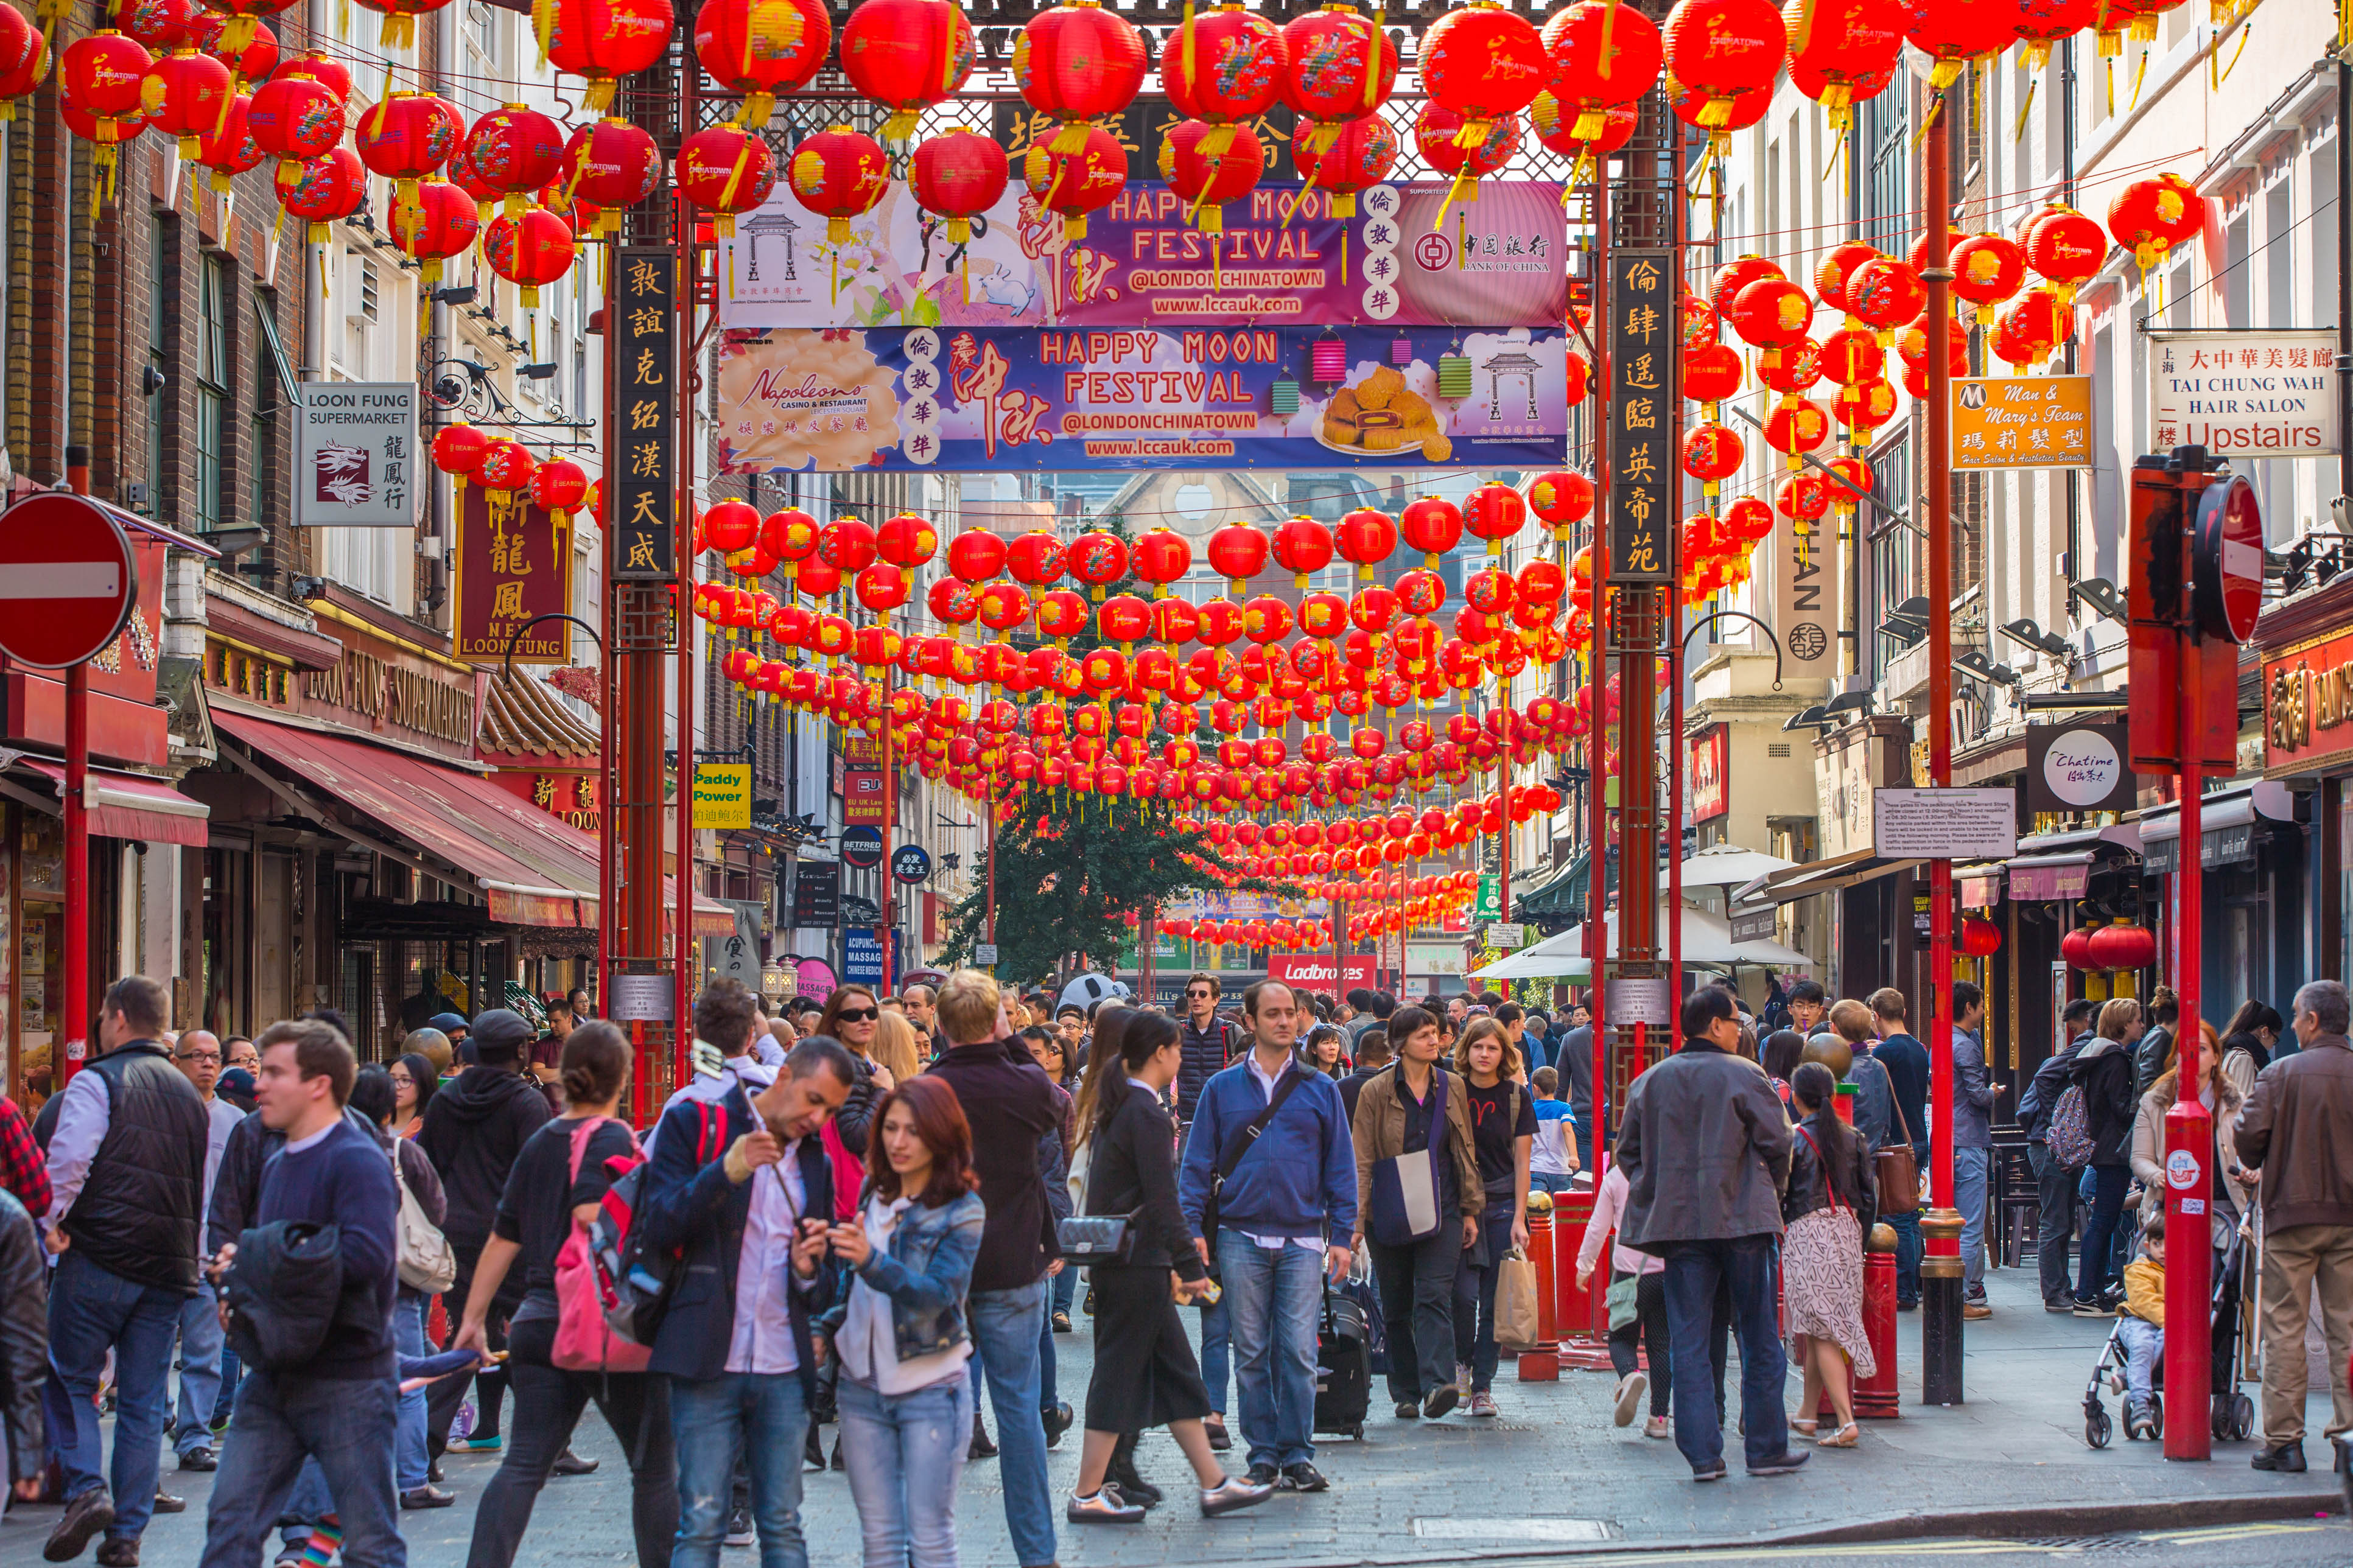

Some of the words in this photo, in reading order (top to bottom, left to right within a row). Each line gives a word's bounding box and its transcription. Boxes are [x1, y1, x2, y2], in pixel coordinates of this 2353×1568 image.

[612, 15, 665, 28] CHINATOWN
[1846, 28, 1895, 38] CHINATOWN
[1710, 36, 1764, 46] CHINATOWN
[1492, 58, 1538, 74] CHINATOWN
[96, 71, 139, 80] CHINATOWN
[1420, 128, 1457, 139] CHINATOWN
[689, 166, 732, 175] CHINATOWN
[1089, 171, 1124, 181] CHINATOWN
[1110, 189, 1203, 221] HAP
[1133, 229, 1321, 261] FESTIVAL
[1369, 190, 1393, 312] 倫敦華埠
[1464, 233, 1550, 258] 中國銀行
[2055, 245, 2092, 254] CHINATOWN
[1464, 262, 1493, 272] BANK
[1496, 262, 1510, 271] OF
[1513, 262, 1549, 271] CHINA
[1131, 271, 1324, 288] @LONDONCHINATOWN
[738, 287, 804, 295] 倫敦華埠商會
[1155, 297, 1300, 313] www.lccauk.com
[1041, 332, 1158, 364] HAPPY
[1183, 331, 1277, 363] MOON
[2162, 348, 2174, 373] 上海
[2189, 348, 2333, 370] 大中華美髮廊
[738, 365, 869, 408] Napoleons
[1064, 371, 1254, 404] FESTIVAL
[2170, 379, 2200, 392] TAI
[2208, 377, 2275, 391] CHUNG
[2283, 377, 2324, 390] WAH
[309, 394, 356, 407] LOON
[362, 394, 409, 407] FUNG
[910, 335, 933, 458] 倫敦華埠
[2004, 384, 2041, 402] Man
[2046, 384, 2058, 400] &
[820, 399, 868, 408] RESTAURANT
[2189, 400, 2238, 414] HAIR
[2245, 399, 2306, 413] SALON
[309, 413, 408, 425] SUPERMARKET
[1064, 415, 1255, 432] @LONDONCHINATOWN
[1985, 406, 2039, 428] Mary's
[2043, 405, 2085, 423] Team
[1961, 427, 2085, 450] 瑪莉髮型
[2186, 421, 2322, 454] Upstairs
[1087, 439, 1233, 455] www.lccauk.com
[1962, 454, 1980, 464] Hair
[1983, 453, 2006, 463] Salon
[2008, 453, 2015, 463] &
[2016, 453, 2055, 463] Aesthetics
[2058, 452, 2085, 463] Beauty
[384, 435, 406, 511] 龍鳳行
[489, 622, 533, 638] NEW
[463, 639, 509, 653] LOON
[514, 640, 560, 654] FUNG
[351, 649, 387, 719] FUNG
[391, 665, 475, 747] SUPERMARKET
[2056, 755, 2113, 767] Chatime
[693, 774, 741, 787] Paddy
[693, 791, 742, 802] Power
[902, 853, 921, 864] 必发
[896, 864, 927, 875] 奖金王
[848, 952, 882, 962] MASSAG
[847, 965, 865, 975] CHINESE
[866, 966, 882, 975] MEDICIN
